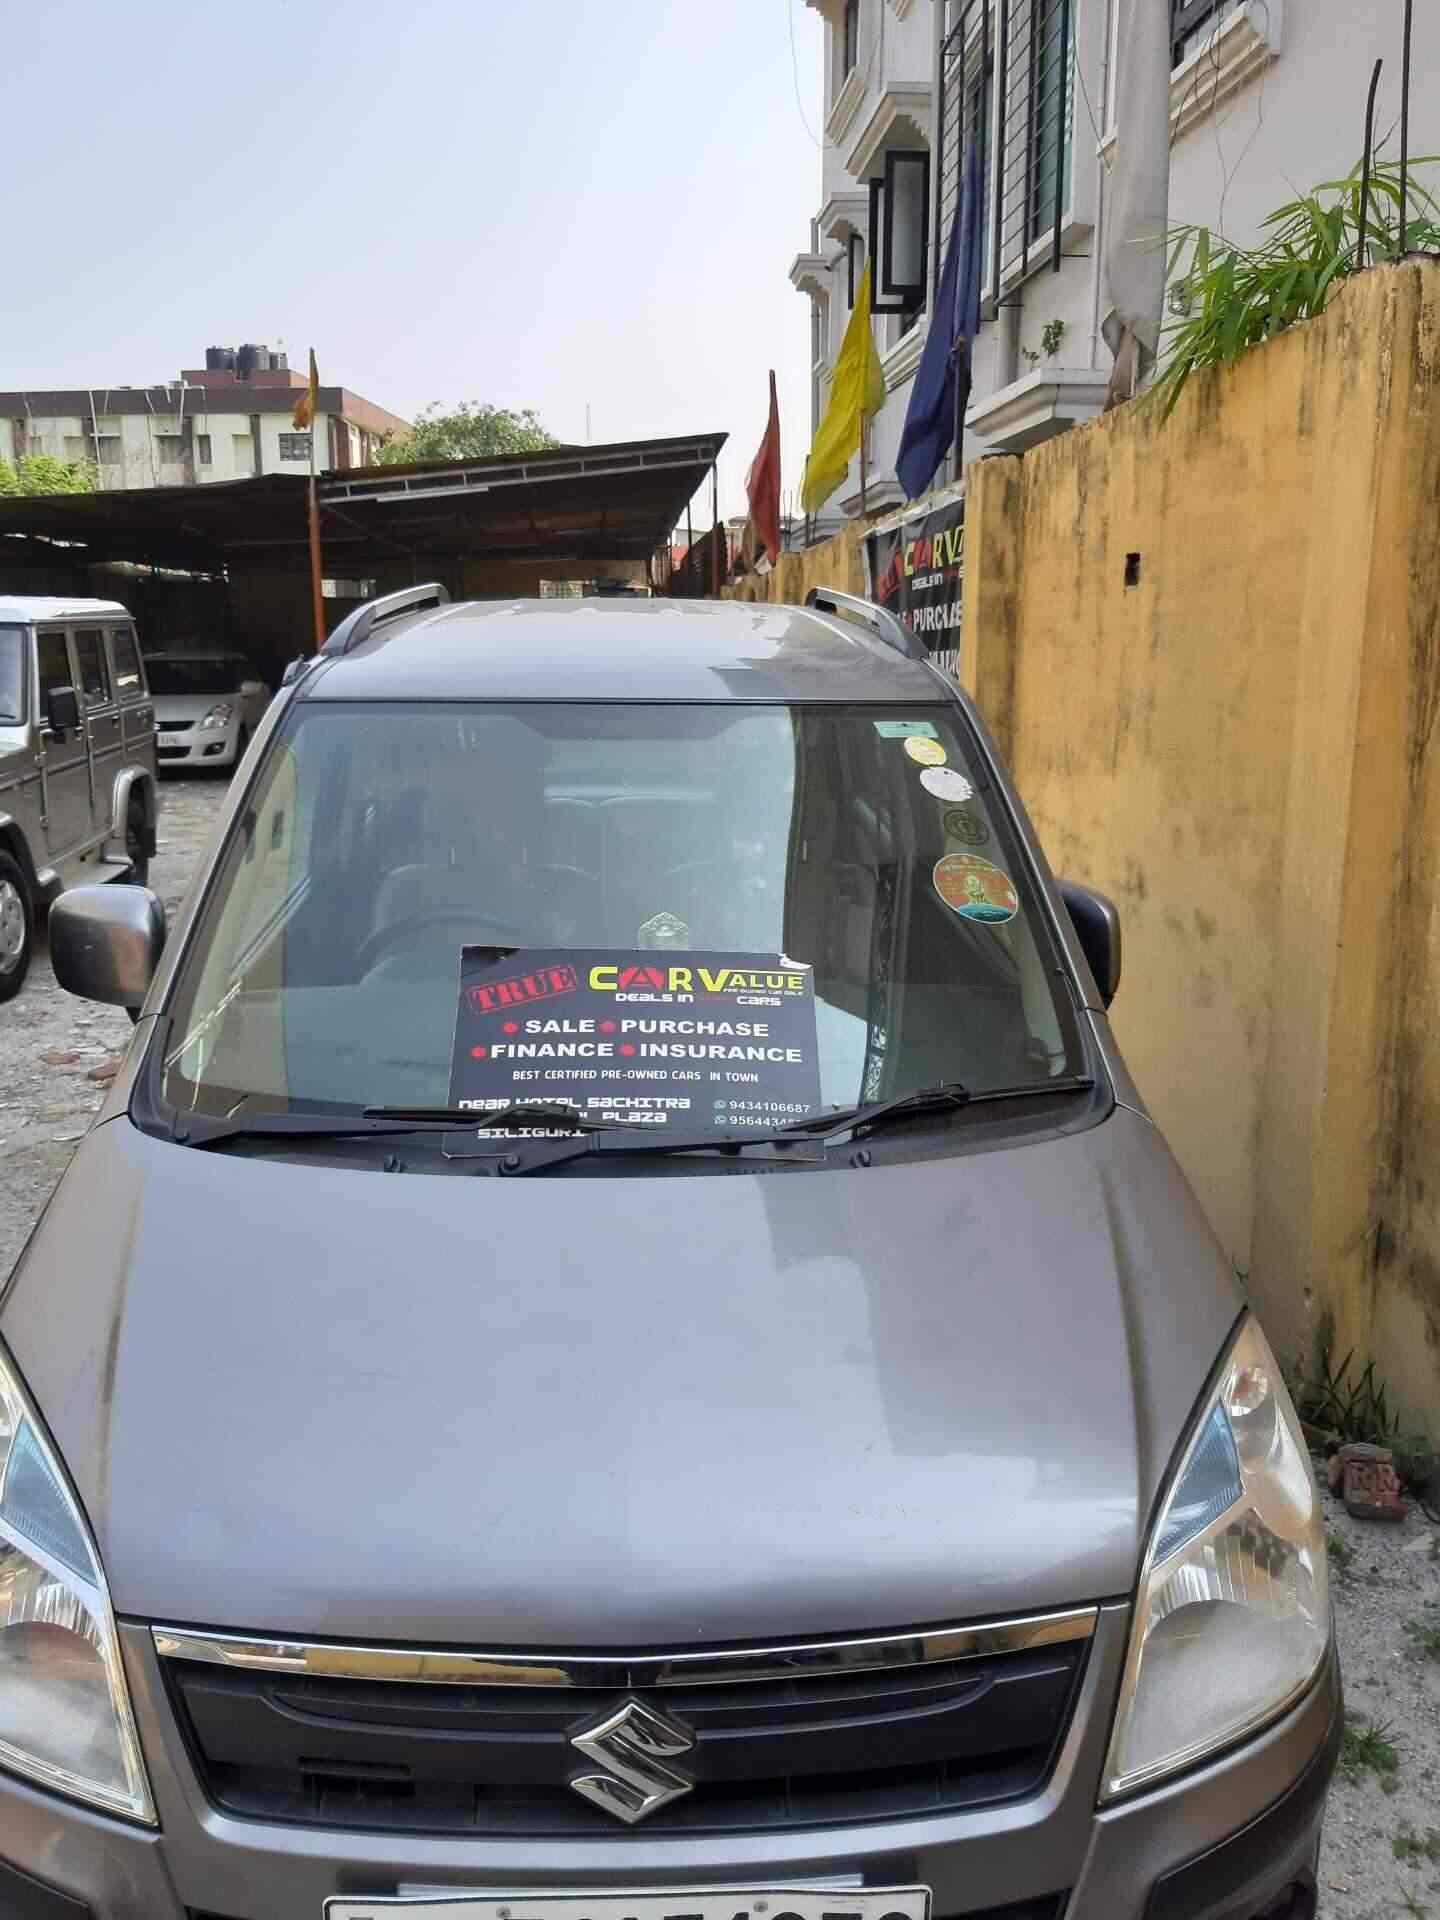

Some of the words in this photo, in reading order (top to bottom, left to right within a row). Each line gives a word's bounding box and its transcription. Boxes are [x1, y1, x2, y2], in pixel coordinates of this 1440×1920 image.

[473, 967, 574, 1010] TRUE
[525, 1019, 596, 1034] SALE
[621, 1020, 769, 1038] PURCHASE
[490, 1043, 614, 1059] FINANCE
[640, 1043, 803, 1063] INSURANCE
[513, 1070, 539, 1081] BEST
[545, 1070, 597, 1080] CERTIFIED
[601, 1070, 668, 1081] PRE-OWNED
[671, 1070, 701, 1081] CARS
[710, 1071, 721, 1081] IN
[725, 1071, 759, 1082] TOWN
[587, 1097, 691, 1109] SACHITRA
[729, 1099, 811, 1114] 9434106687
